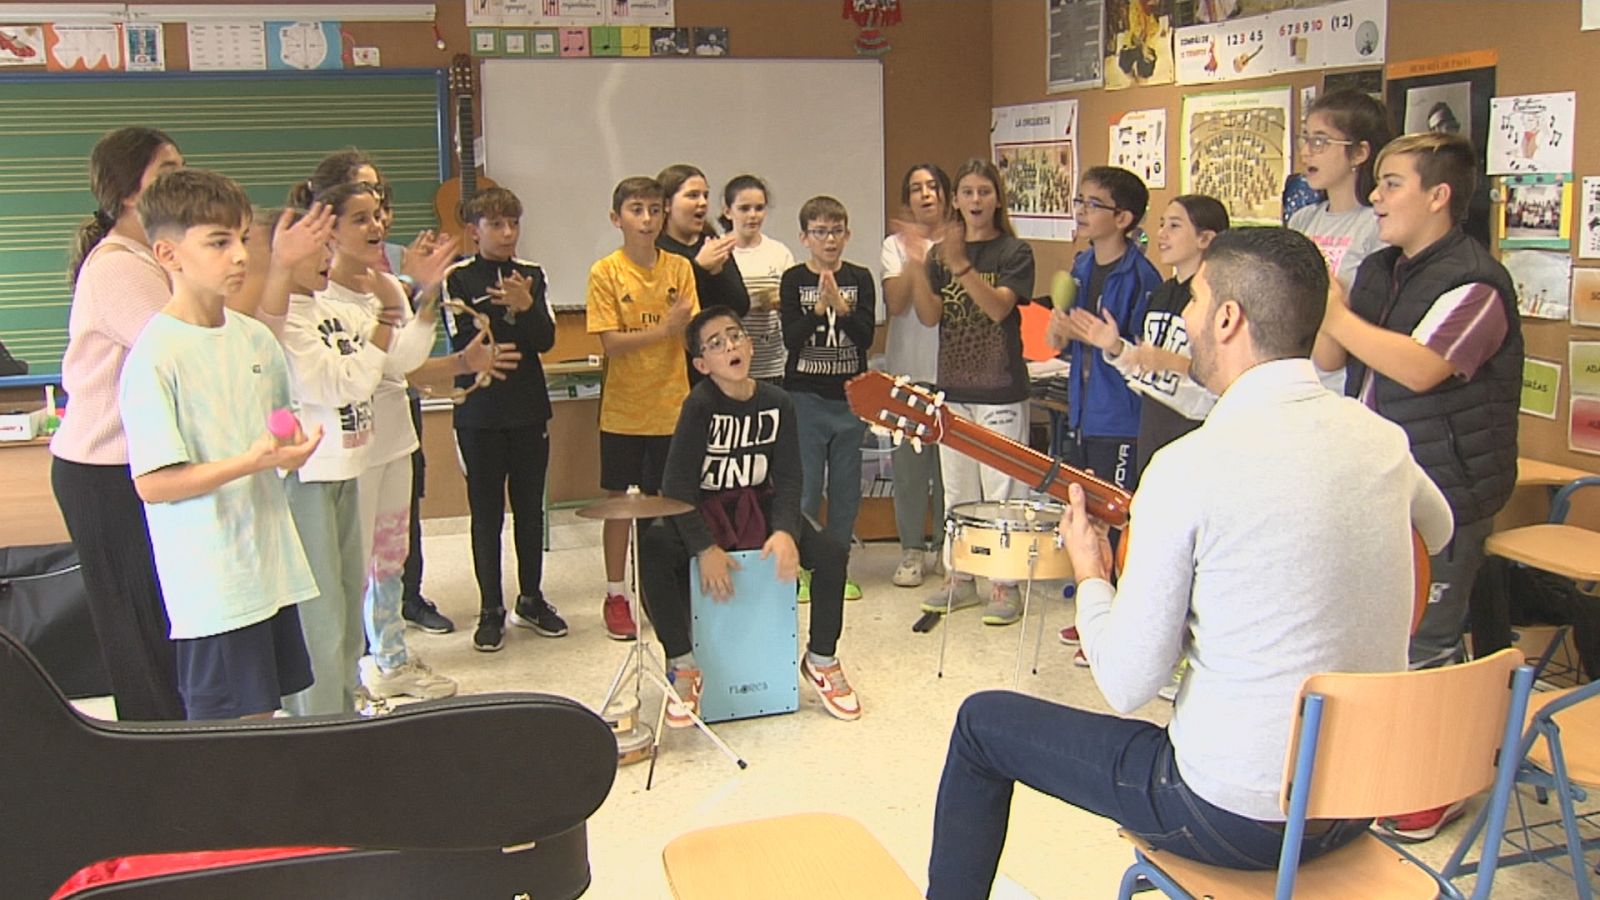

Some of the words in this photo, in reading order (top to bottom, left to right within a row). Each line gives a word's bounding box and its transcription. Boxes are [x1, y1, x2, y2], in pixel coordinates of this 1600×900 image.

[642, 313, 660, 325] Fly
[708, 408, 780, 453] WILD
[700, 453, 769, 491] AND
